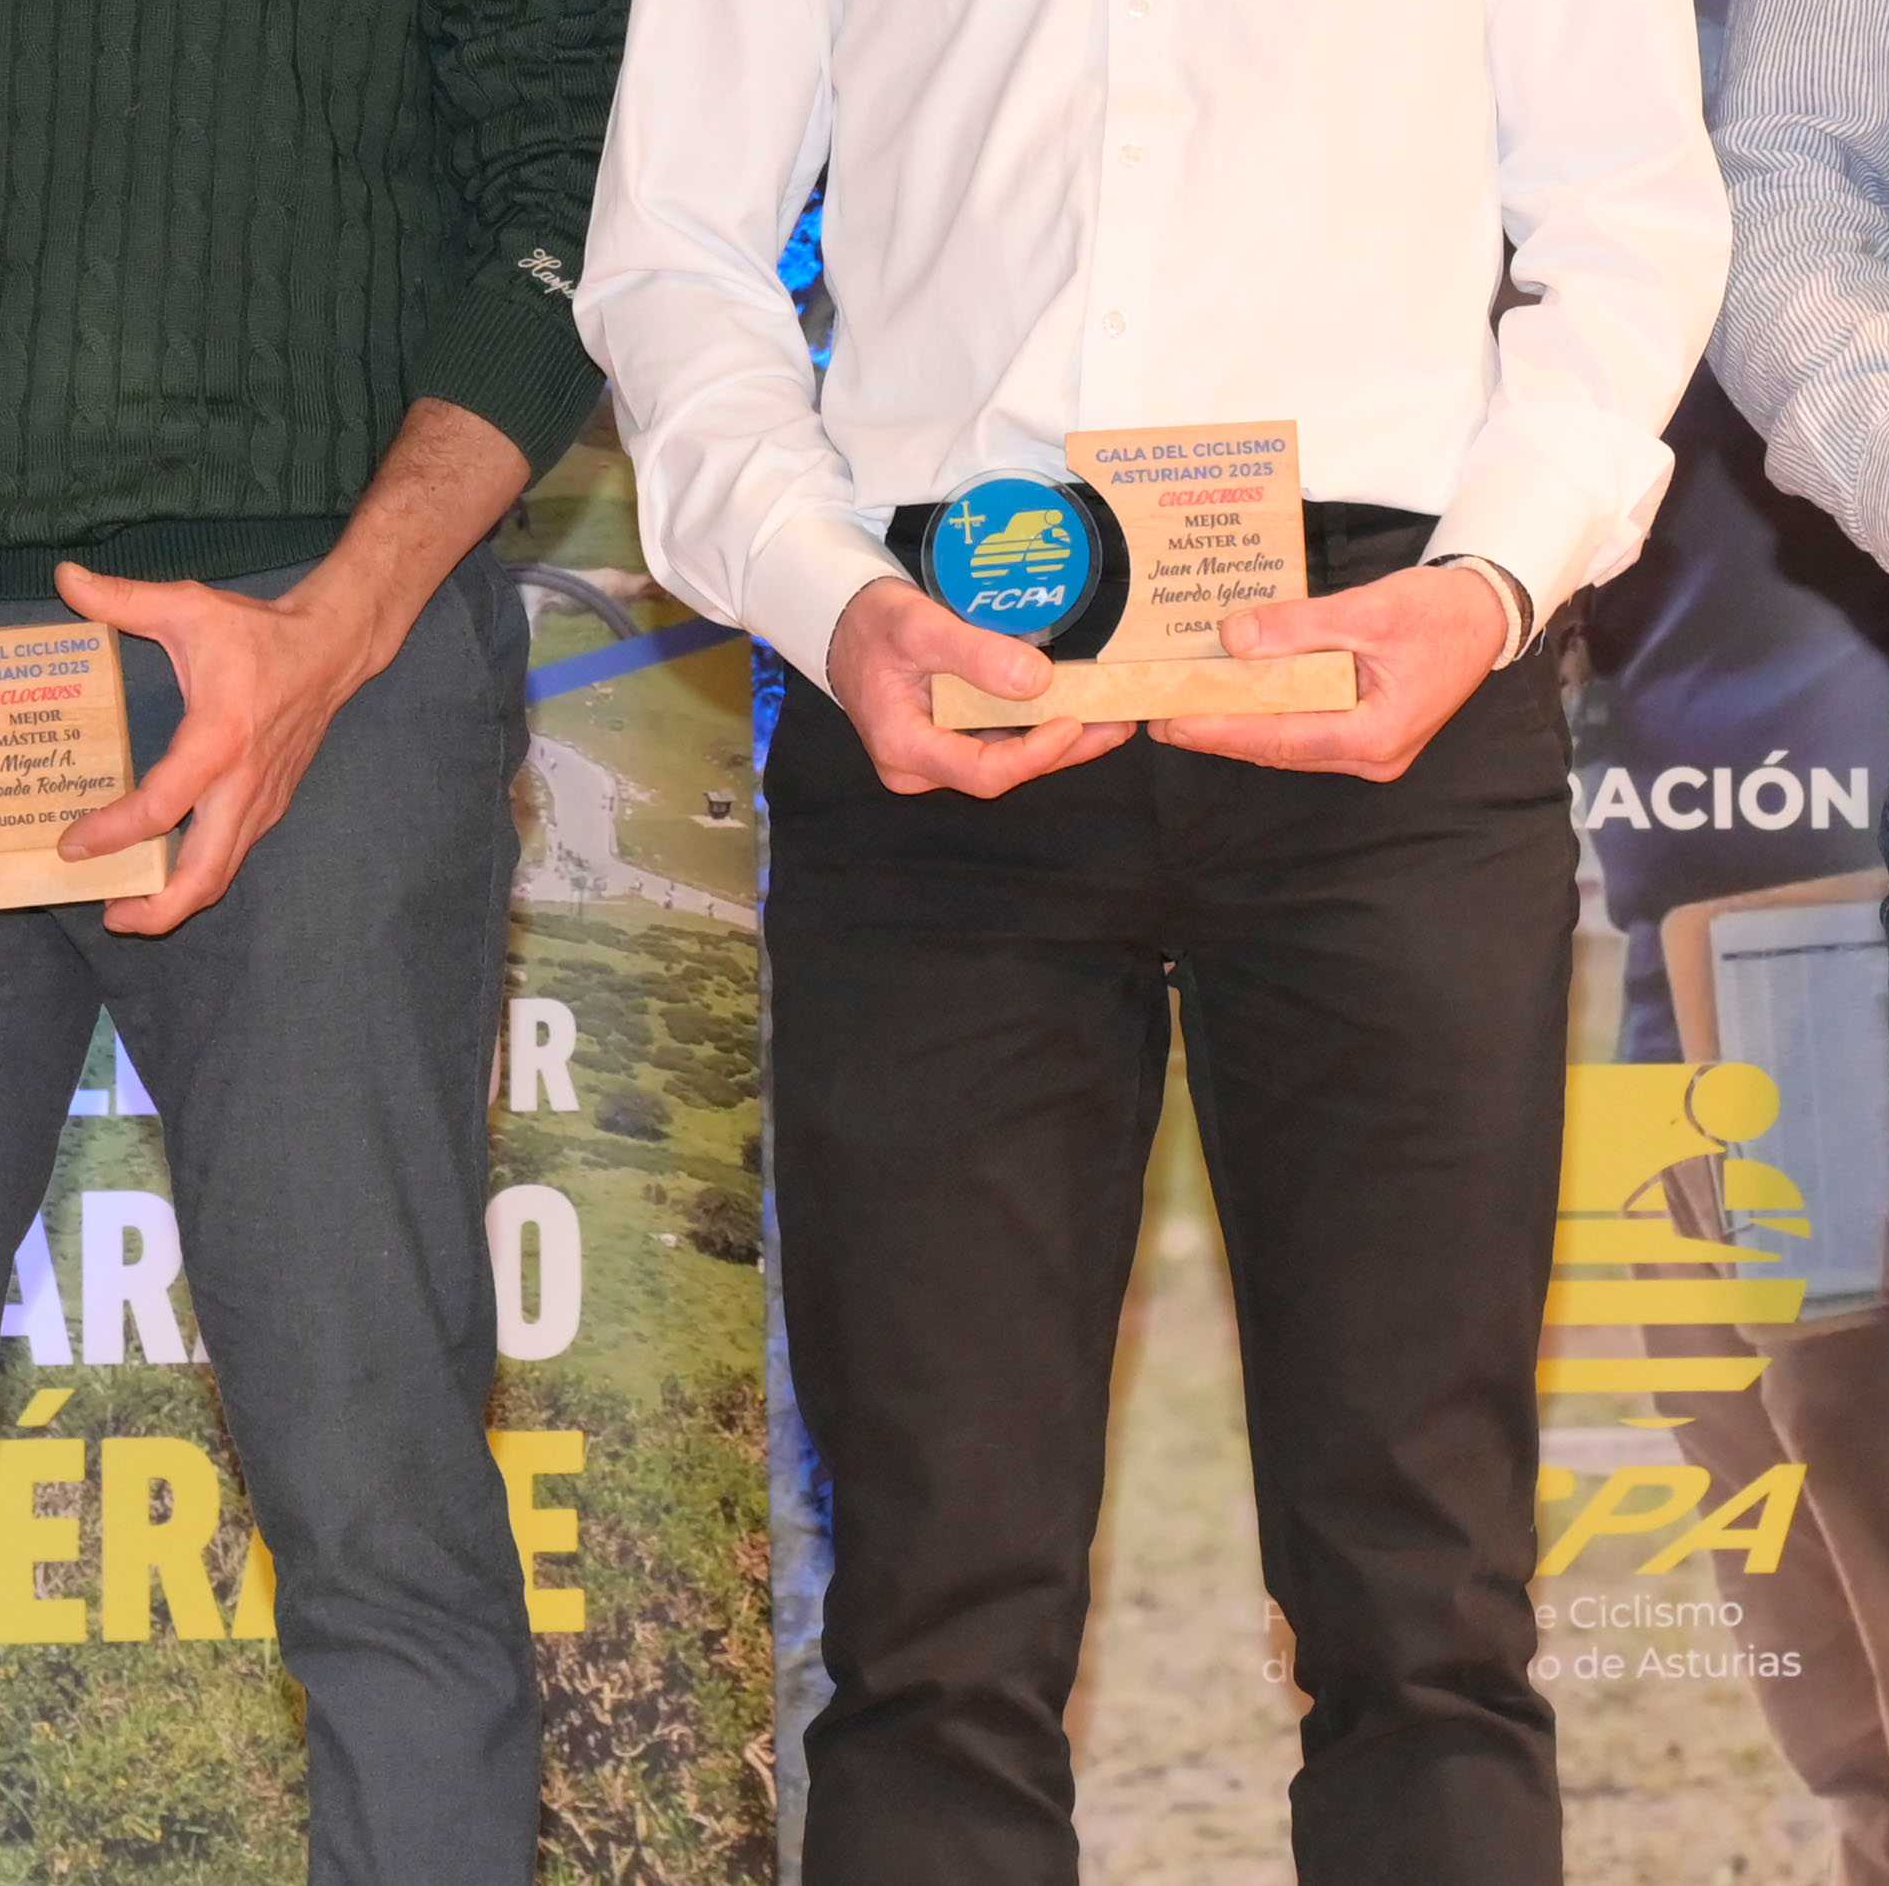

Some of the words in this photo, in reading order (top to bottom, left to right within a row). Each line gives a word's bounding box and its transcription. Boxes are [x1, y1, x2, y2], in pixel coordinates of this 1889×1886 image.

[1095, 447, 1147, 463] GALA
[1152, 444, 1188, 460] DEL
[1193, 438, 1286, 458] CICLISMO
[1111, 465, 1223, 485] ASTURIANO
[1229, 461, 1275, 478] 2025
[1158, 486, 1265, 507] CICLOCROSS
[1184, 513, 1242, 529] MEJOR
[1168, 533, 1237, 550] MÁSTER
[1242, 533, 1261, 546] 60
[1148, 560, 1192, 580] Juan
[1196, 552, 1285, 576] Marcelino
[967, 584, 1065, 613] FCPA
[1217, 580, 1278, 607] Iglesias
[14, 637, 101, 658] CICLISMO
[47, 660, 90, 676] 2025
[8, 709, 63, 726] MEJOR
[63, 729, 81, 742] 50
[0, 749, 57, 777] Miguel
[60, 749, 76, 767] A.
[36, 774, 116, 797] Rodríguez
[1567, 750, 1869, 831] ACIÓN
[38, 812, 56, 823] DE
[1536, 1463, 1808, 1576] PA
[1570, 1594, 1744, 1628] Ciclismo
[1574, 1646, 1625, 1679] de
[1637, 1644, 1803, 1678] Asturias
